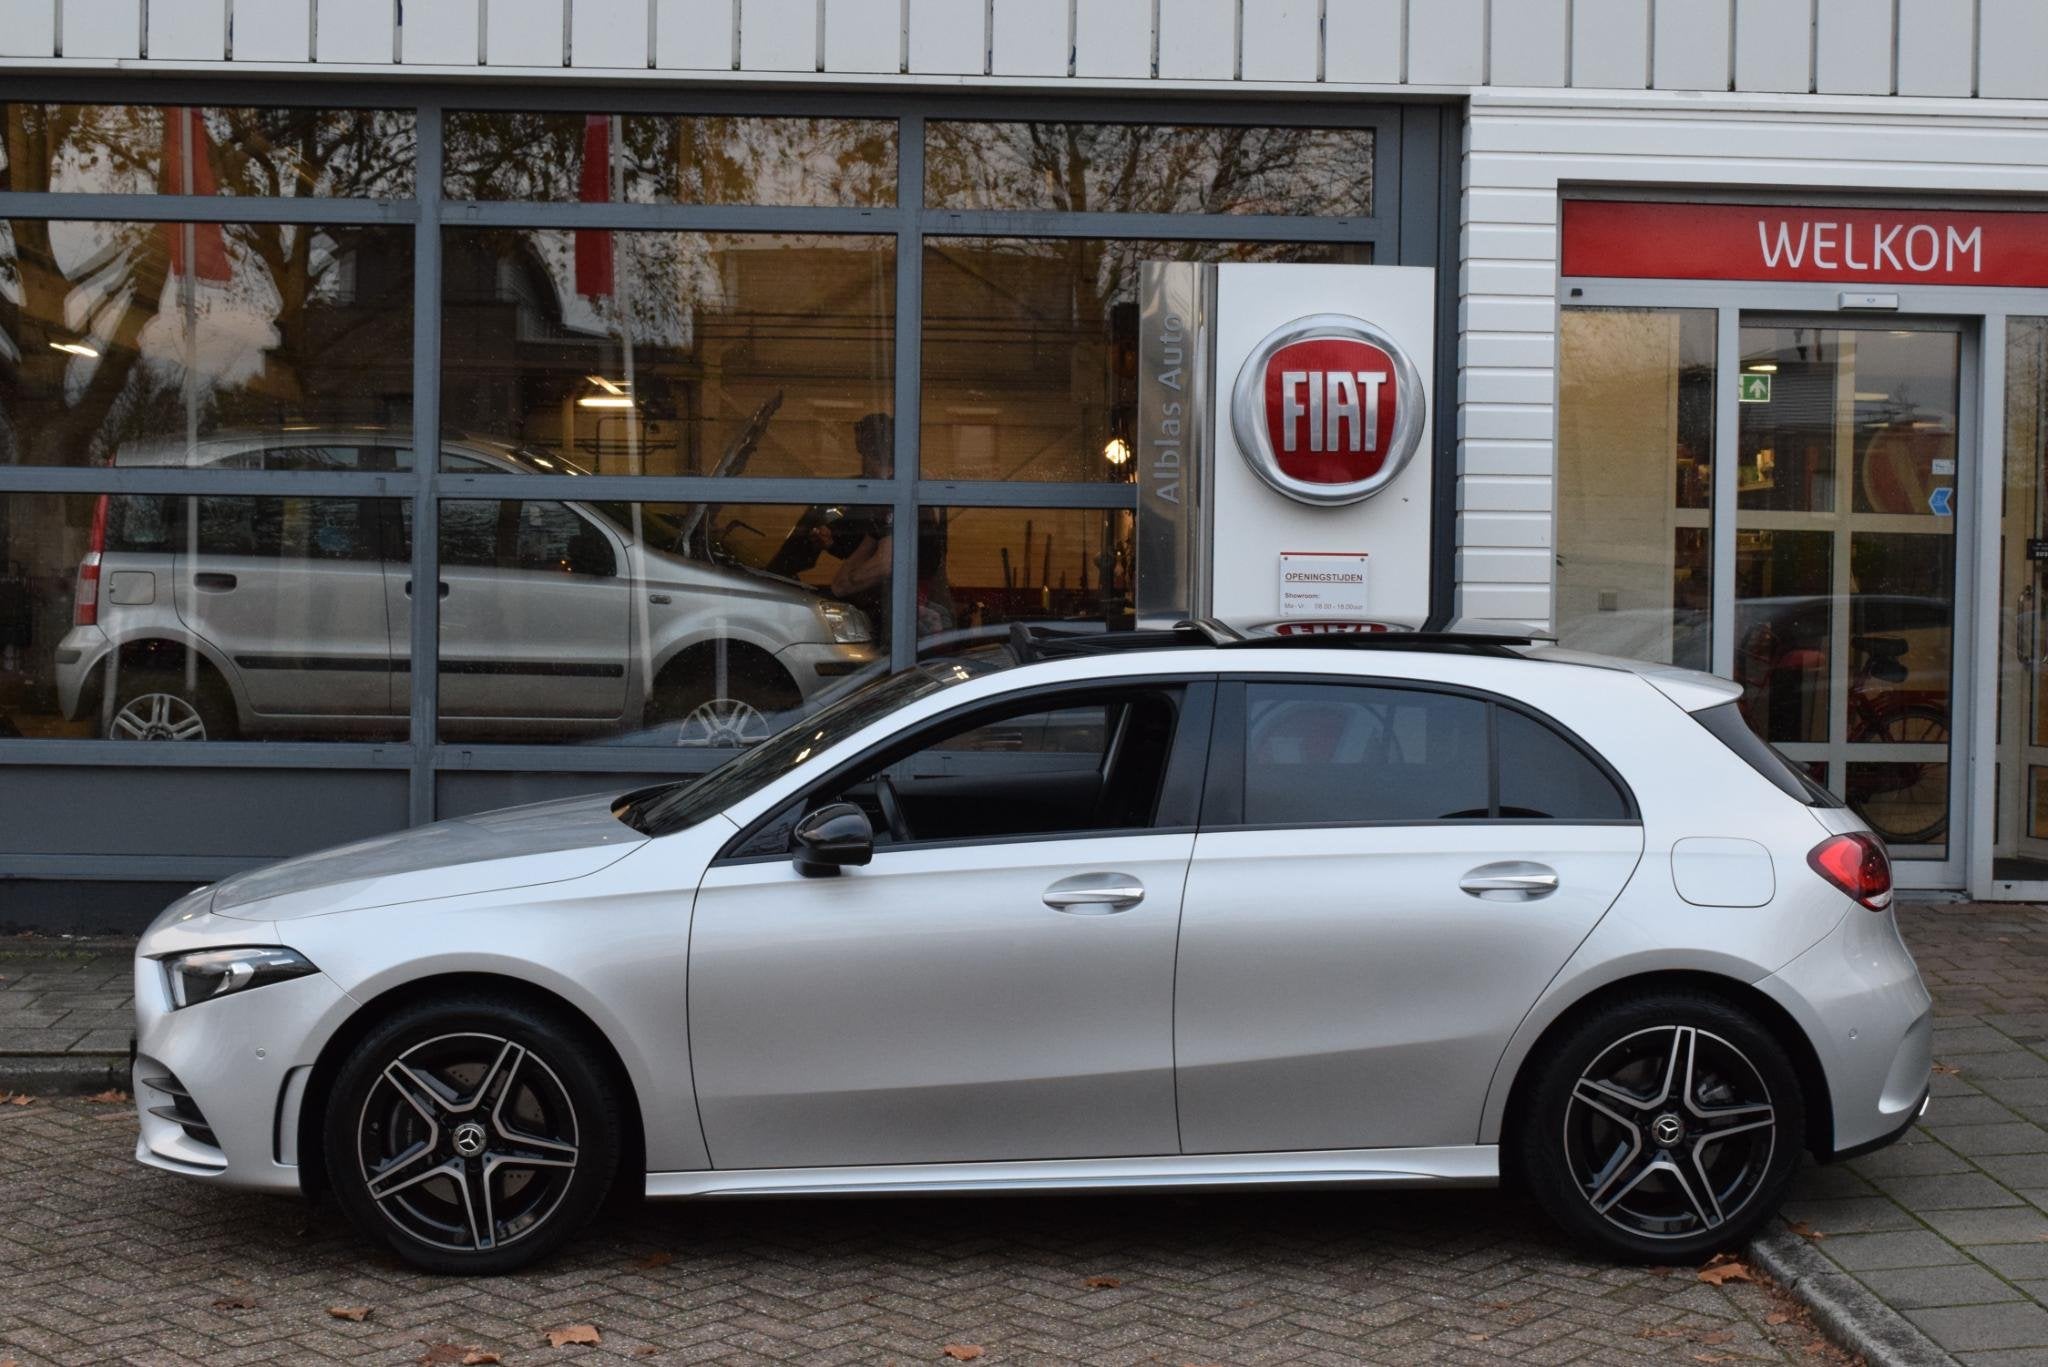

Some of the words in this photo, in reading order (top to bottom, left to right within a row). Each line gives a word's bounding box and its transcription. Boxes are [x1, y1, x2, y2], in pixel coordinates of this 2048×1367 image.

[1758, 220, 1982, 273] WELKOM
[1158, 313, 1183, 391] Auto
[1281, 371, 1387, 453] FIAT
[1153, 402, 1182, 504] Alblas
[1284, 572, 1363, 582] OPENINGSTIJDEN
